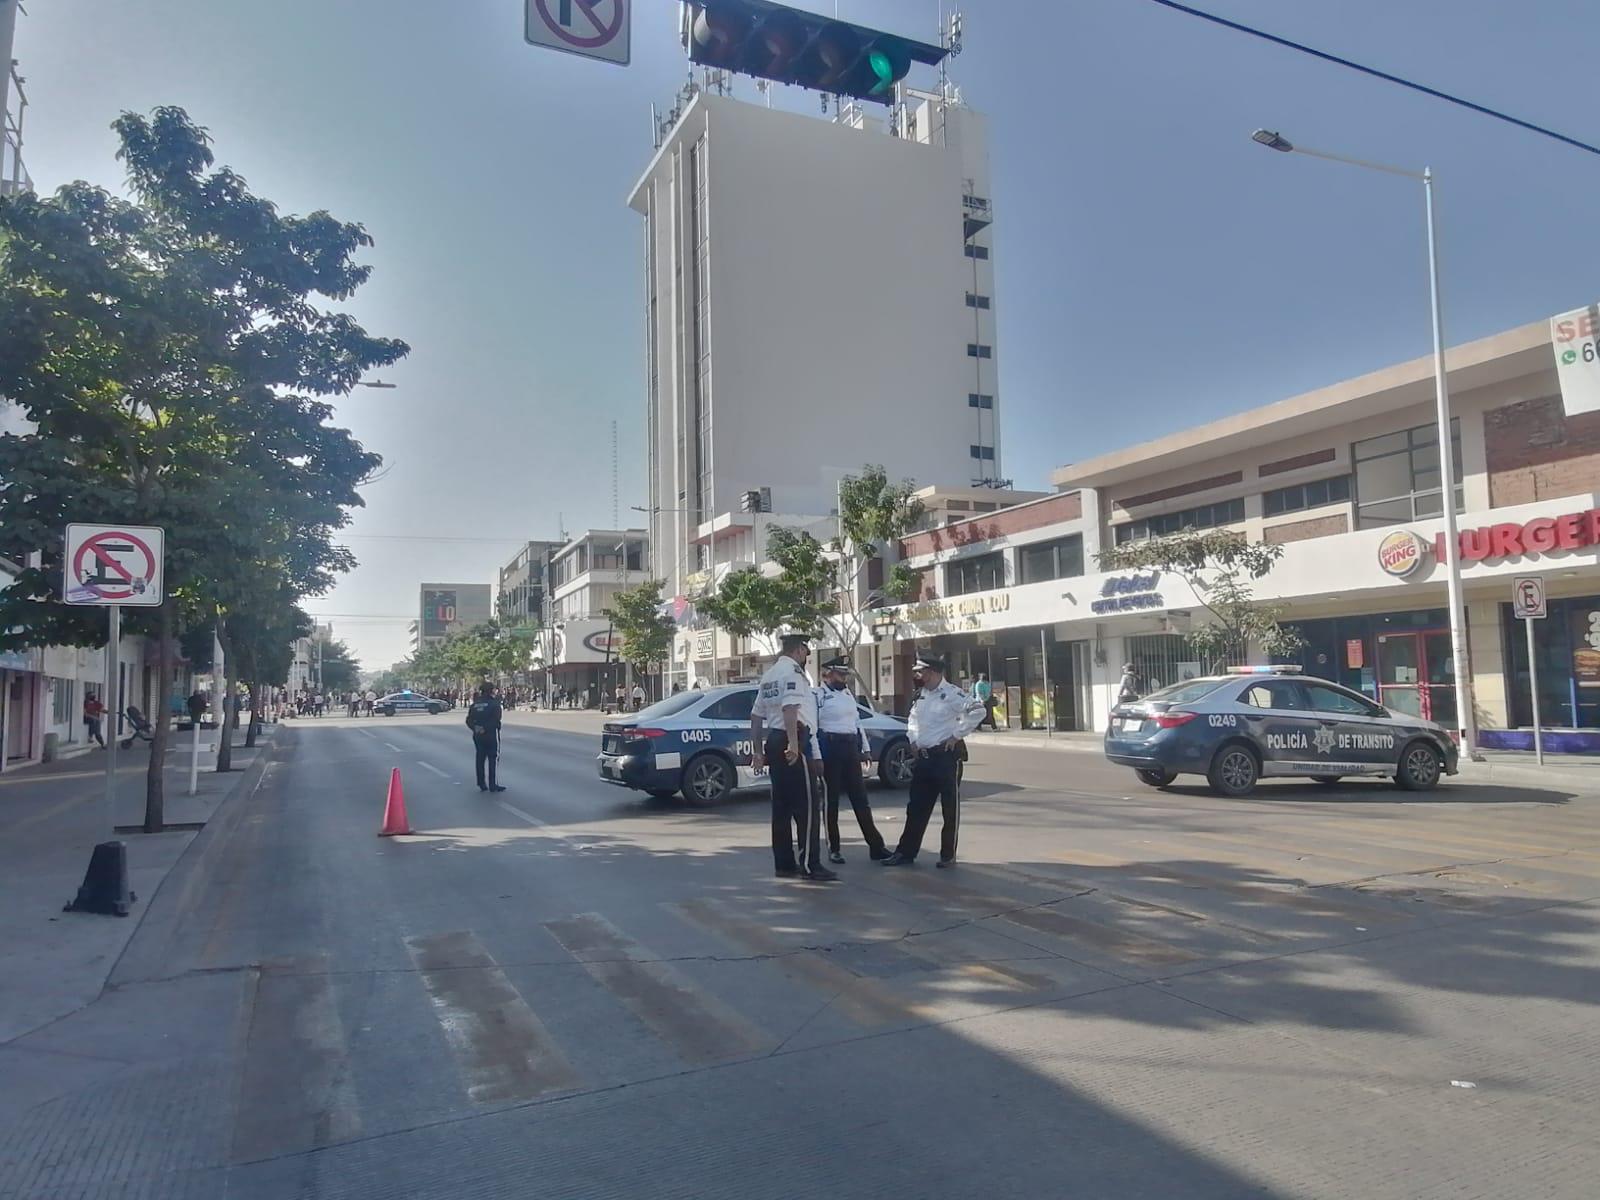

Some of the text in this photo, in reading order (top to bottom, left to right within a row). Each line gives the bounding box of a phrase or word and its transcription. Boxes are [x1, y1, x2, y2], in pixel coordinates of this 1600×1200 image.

[1381, 537, 1414, 559] BURGER
[1384, 545, 1416, 568] KING
[1208, 714, 1237, 727] 0249
[681, 730, 711, 743] 0405
[1267, 731, 1394, 749] POLICÍA DE TRANSITO
